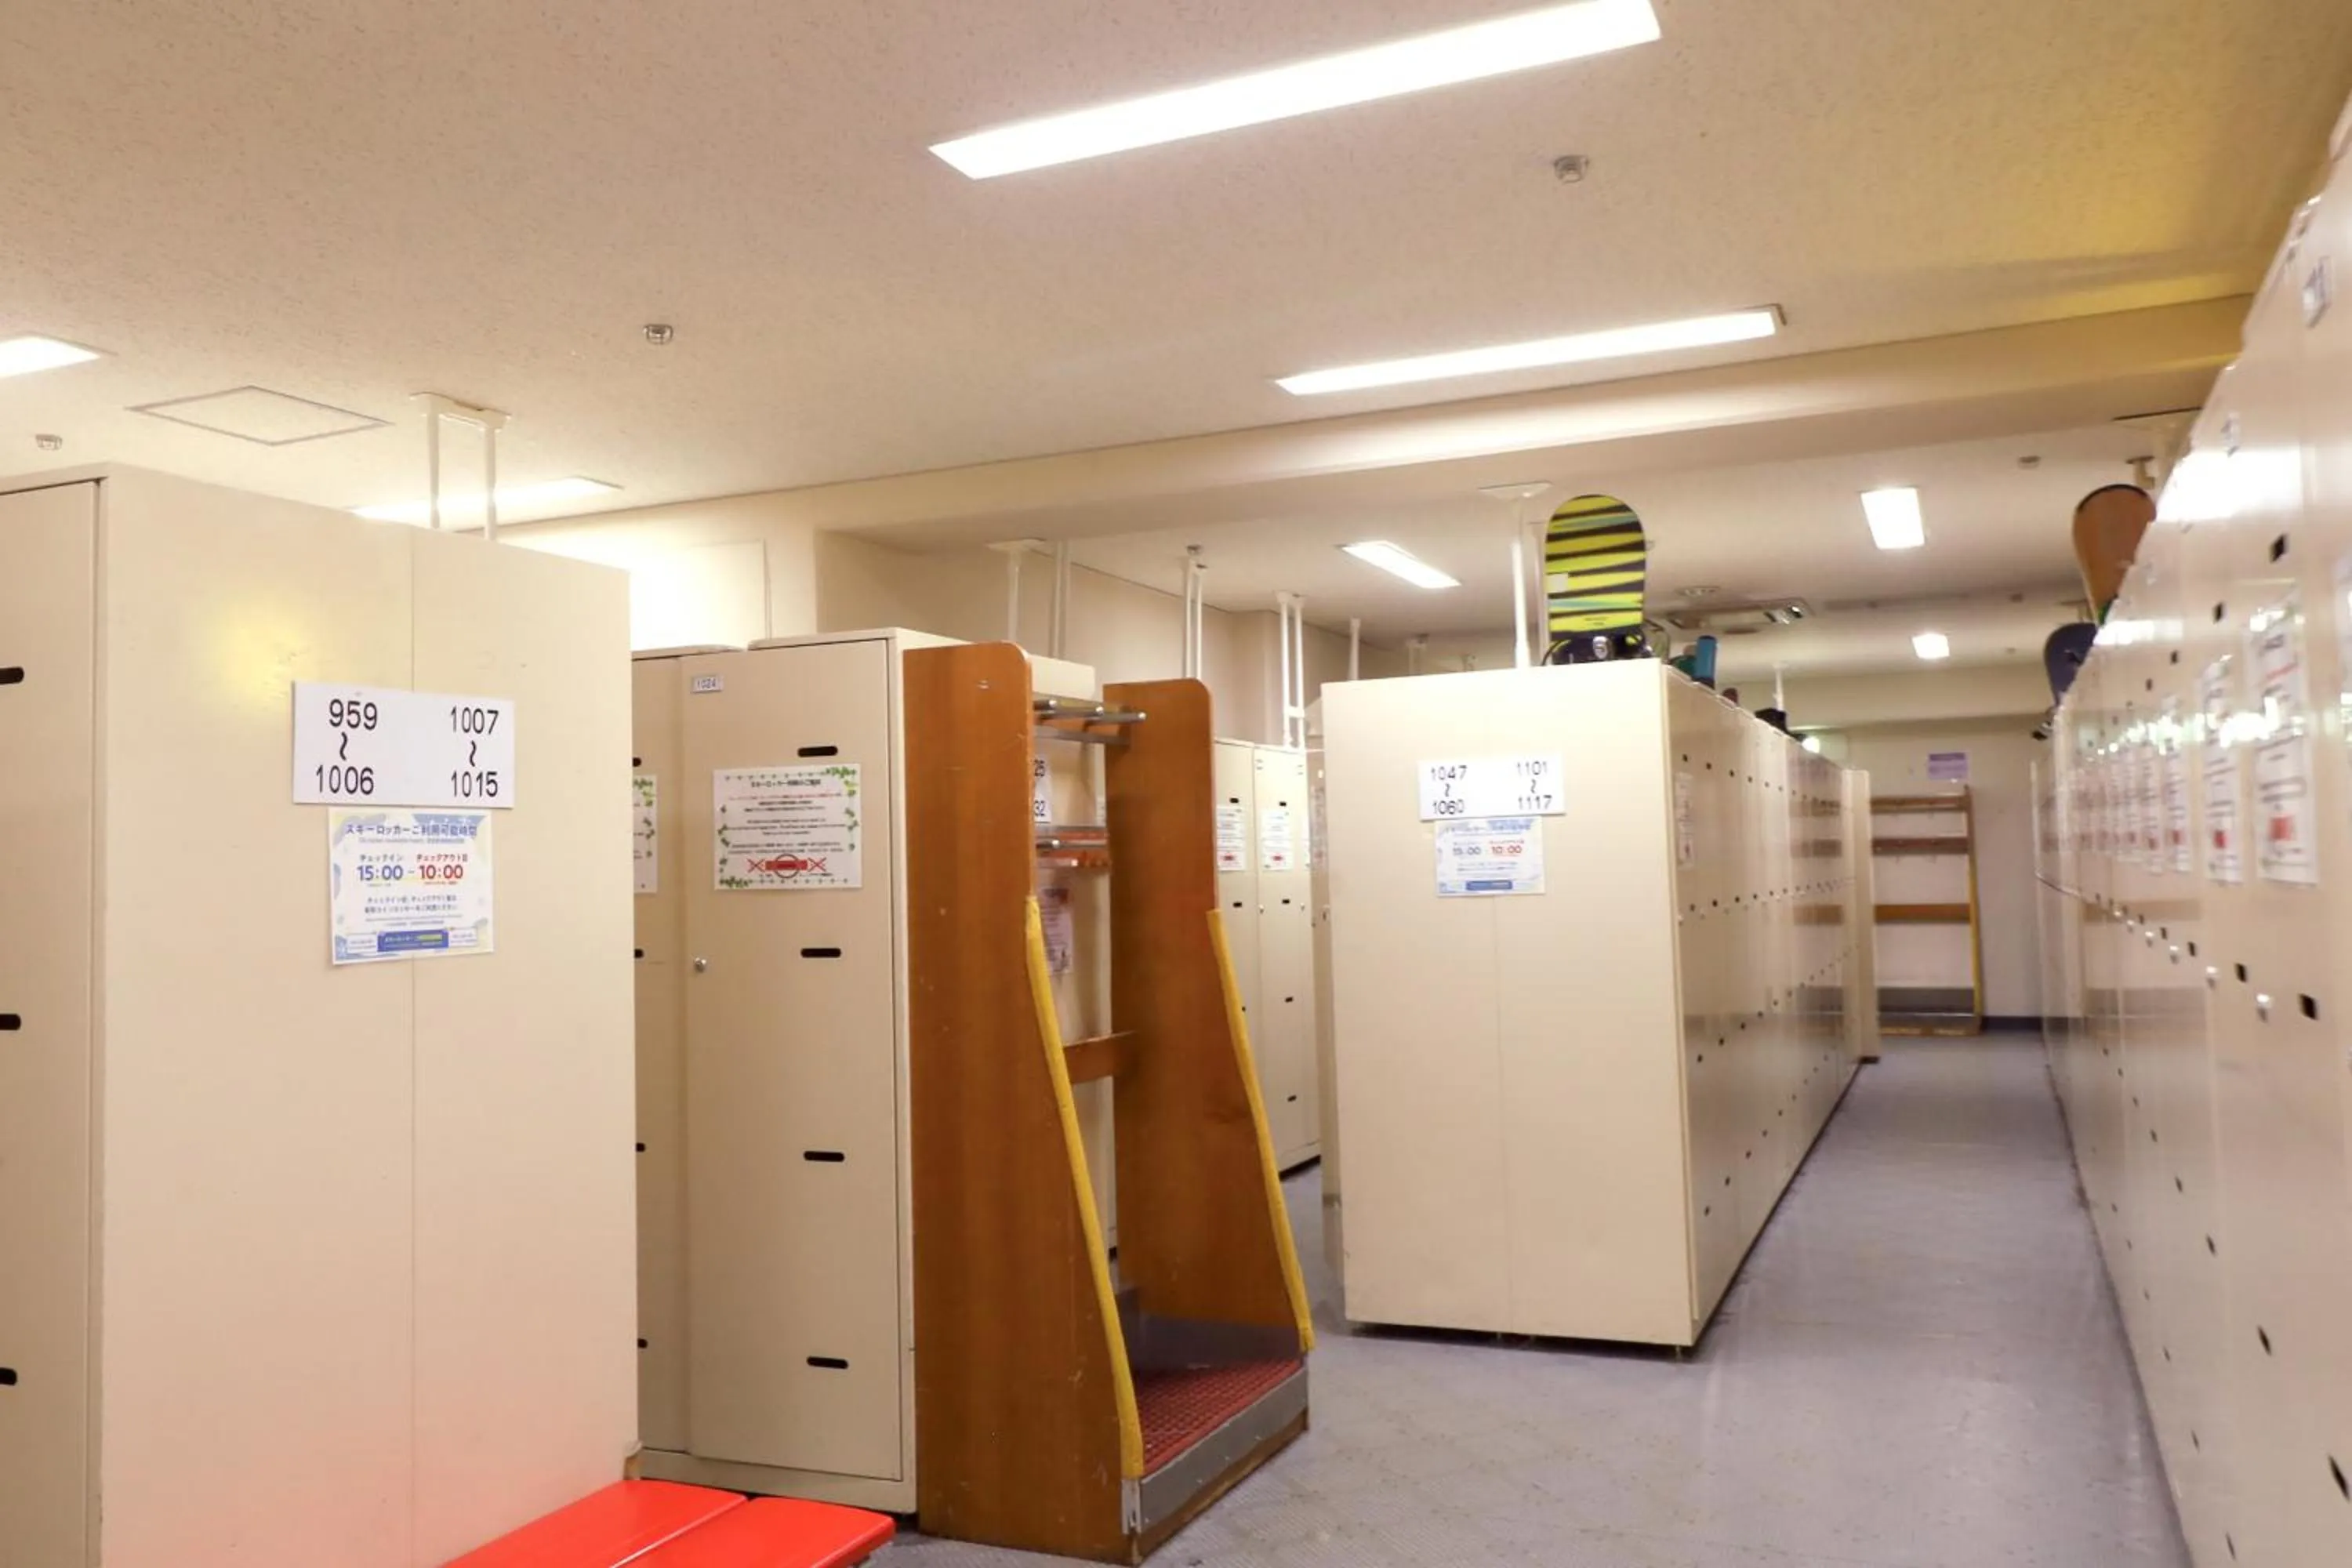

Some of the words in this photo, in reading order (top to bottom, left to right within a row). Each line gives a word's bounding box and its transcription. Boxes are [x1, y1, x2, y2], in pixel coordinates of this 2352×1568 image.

[328, 698, 379, 731] 959
[450, 706, 499, 735] 1007
[1430, 764, 1468, 781] 1047
[1515, 760, 1548, 776] 1101
[315, 764, 375, 796] 1006
[451, 771, 499, 797] 1015
[1432, 799, 1465, 815] 1060
[1518, 794, 1552, 810] 1117
[357, 865, 404, 880] 15:00
[419, 864, 464, 879] 10:00
